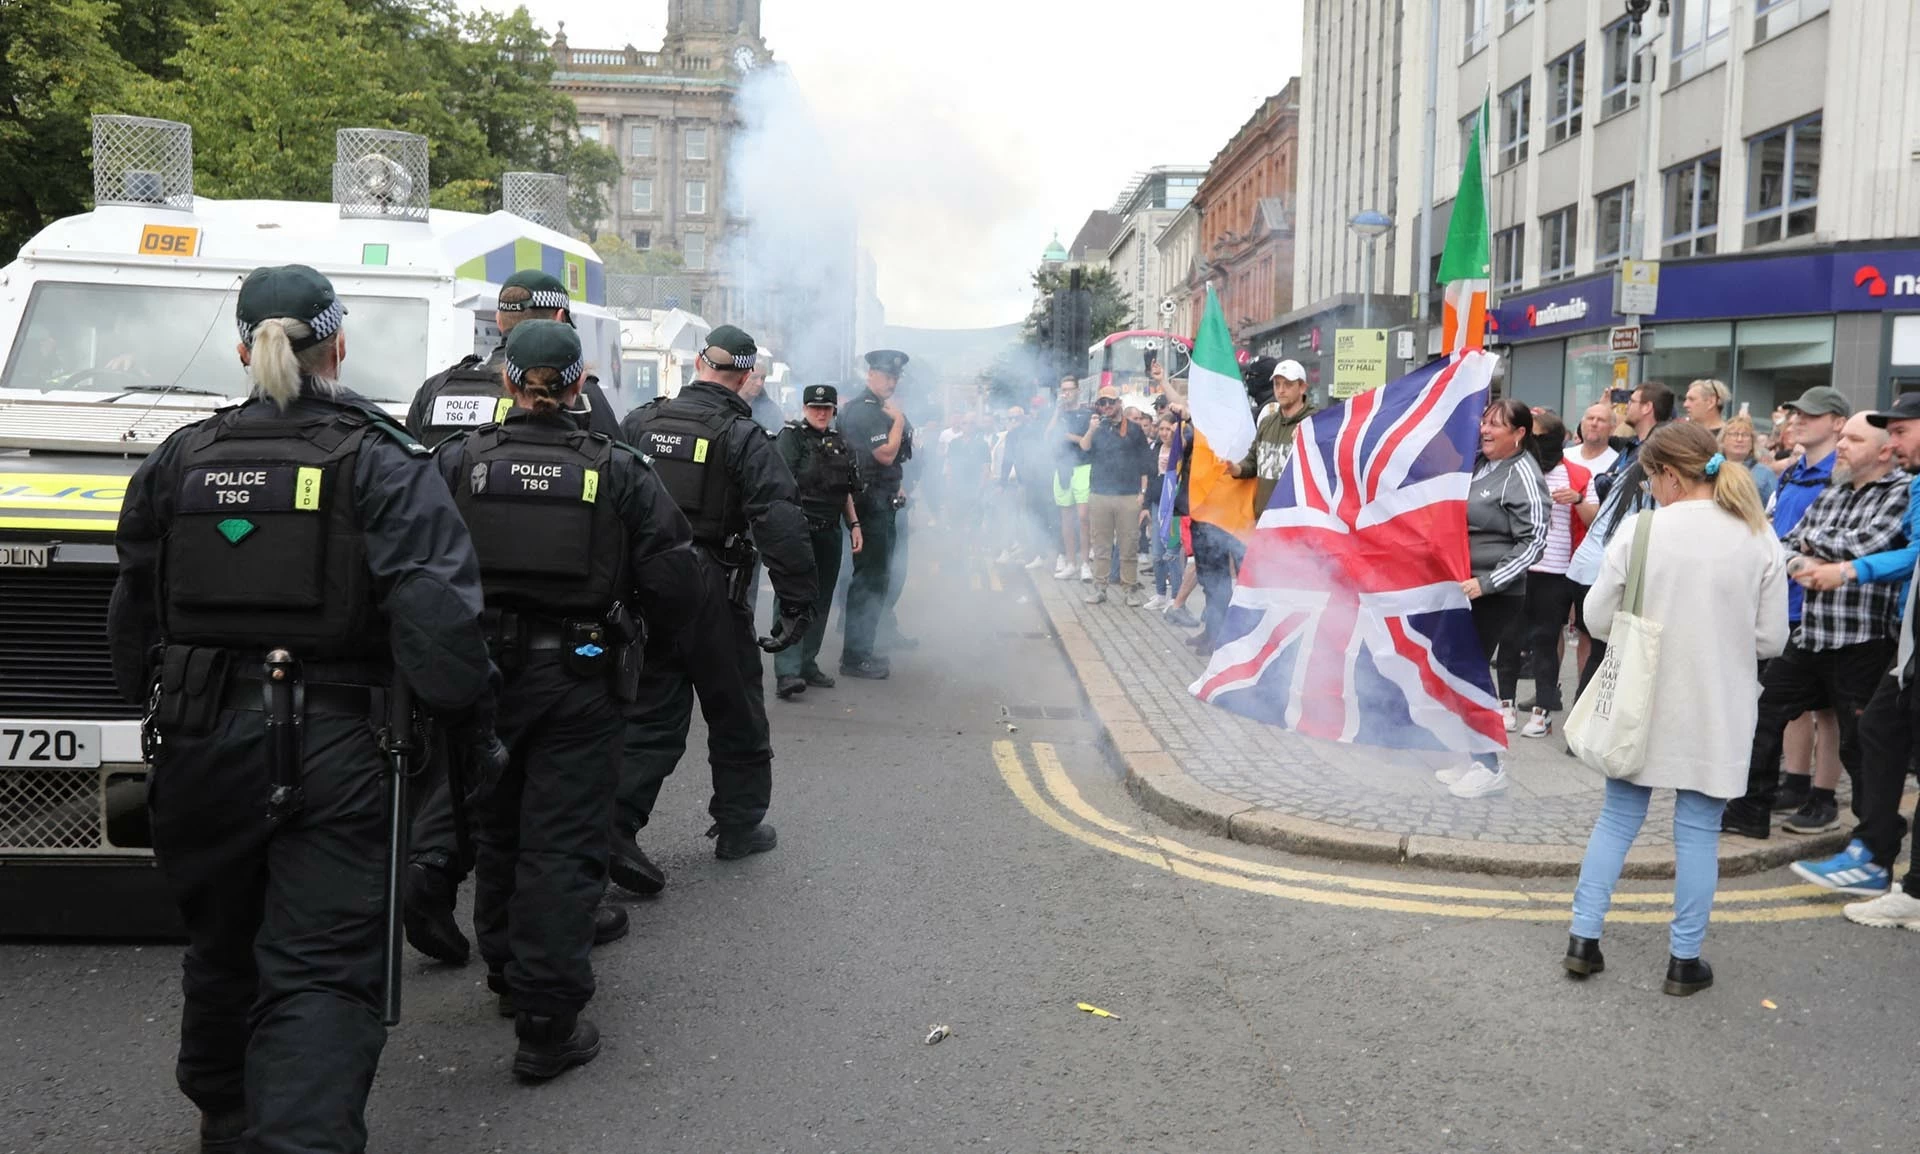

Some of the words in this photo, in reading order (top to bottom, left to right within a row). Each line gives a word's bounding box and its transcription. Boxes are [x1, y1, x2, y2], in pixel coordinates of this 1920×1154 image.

[144, 233, 190, 253] 09E
[446, 400, 479, 409] POLICE
[446, 412, 463, 421] TSG
[651, 433, 682, 445] POLICE
[656, 444, 673, 454] TSG
[511, 464, 562, 477] POLICE
[204, 471, 267, 486] POLICE
[521, 478, 549, 490] TSG
[216, 490, 250, 504] TSG
[2, 729, 77, 761] 720
